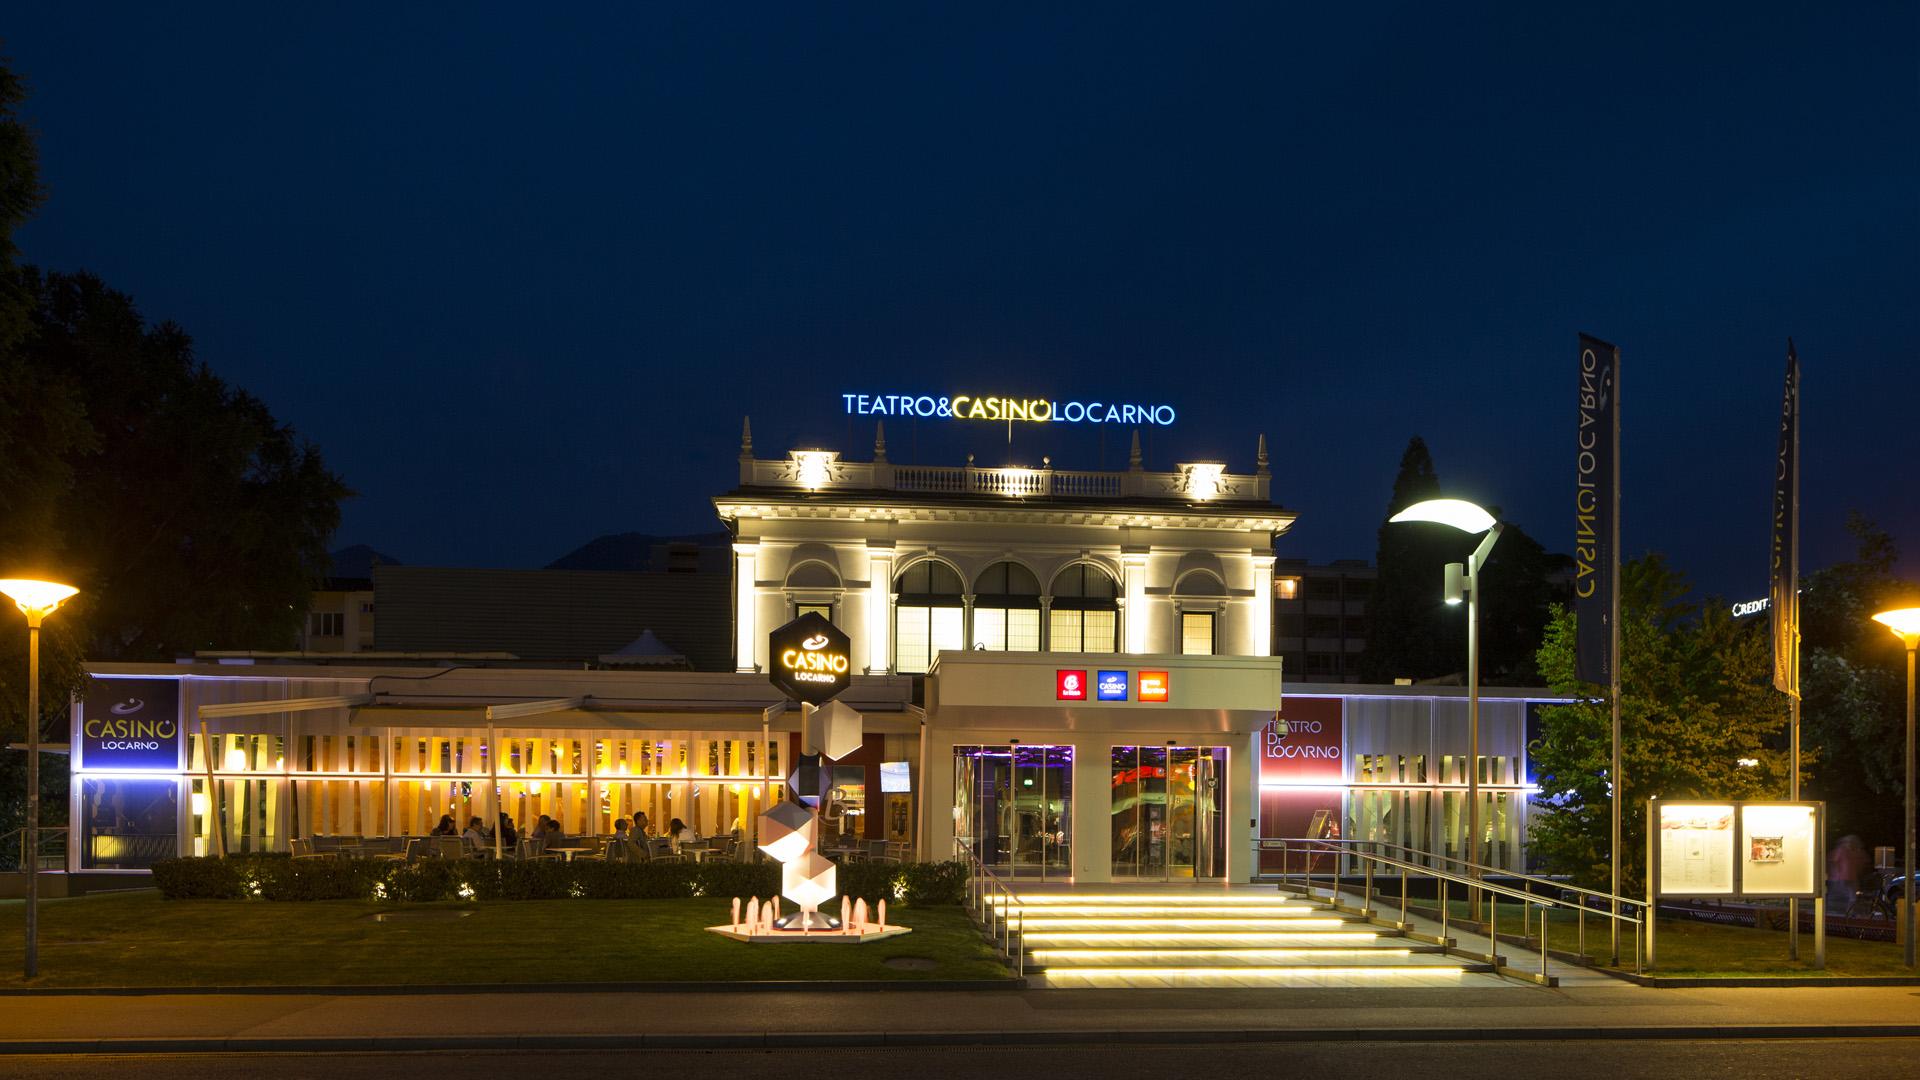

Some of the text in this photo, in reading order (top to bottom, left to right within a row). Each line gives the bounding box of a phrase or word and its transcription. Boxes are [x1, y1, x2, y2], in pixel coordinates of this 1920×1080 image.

[1732, 598, 1768, 617] CREDIT
[782, 650, 848, 673] CASINO
[795, 672, 836, 683] LOCARNO
[1099, 682, 1126, 690] CASINO
[85, 719, 176, 739] CASINO
[101, 741, 159, 750] LOCARNO
[1267, 745, 1340, 759] LOCARNO
